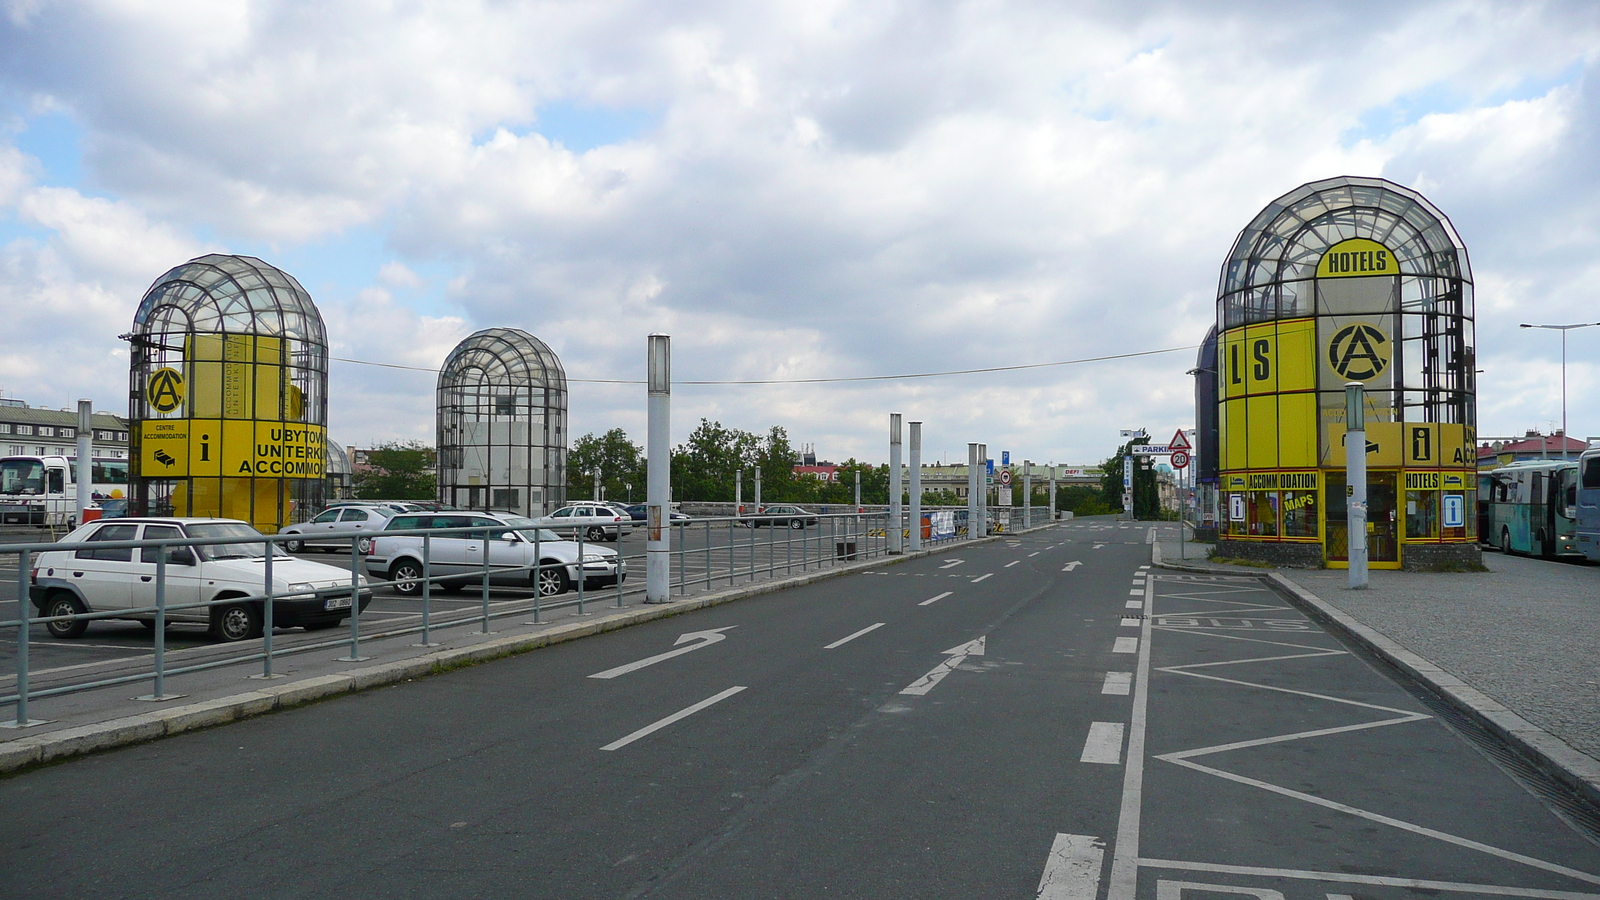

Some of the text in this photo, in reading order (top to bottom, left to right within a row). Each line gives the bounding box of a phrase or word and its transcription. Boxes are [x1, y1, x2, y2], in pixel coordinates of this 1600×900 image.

[1329, 250, 1387, 273] HOTELS
[271, 429, 323, 444] UBYTOV
[257, 444, 323, 459] UNTERK
[1174, 455, 1186, 464] 20
[239, 461, 323, 475] ACCOMMO
[1405, 473, 1438, 488] HOTELS
[1284, 494, 1314, 511] MAPS
[1158, 618, 1309, 630] BUS
